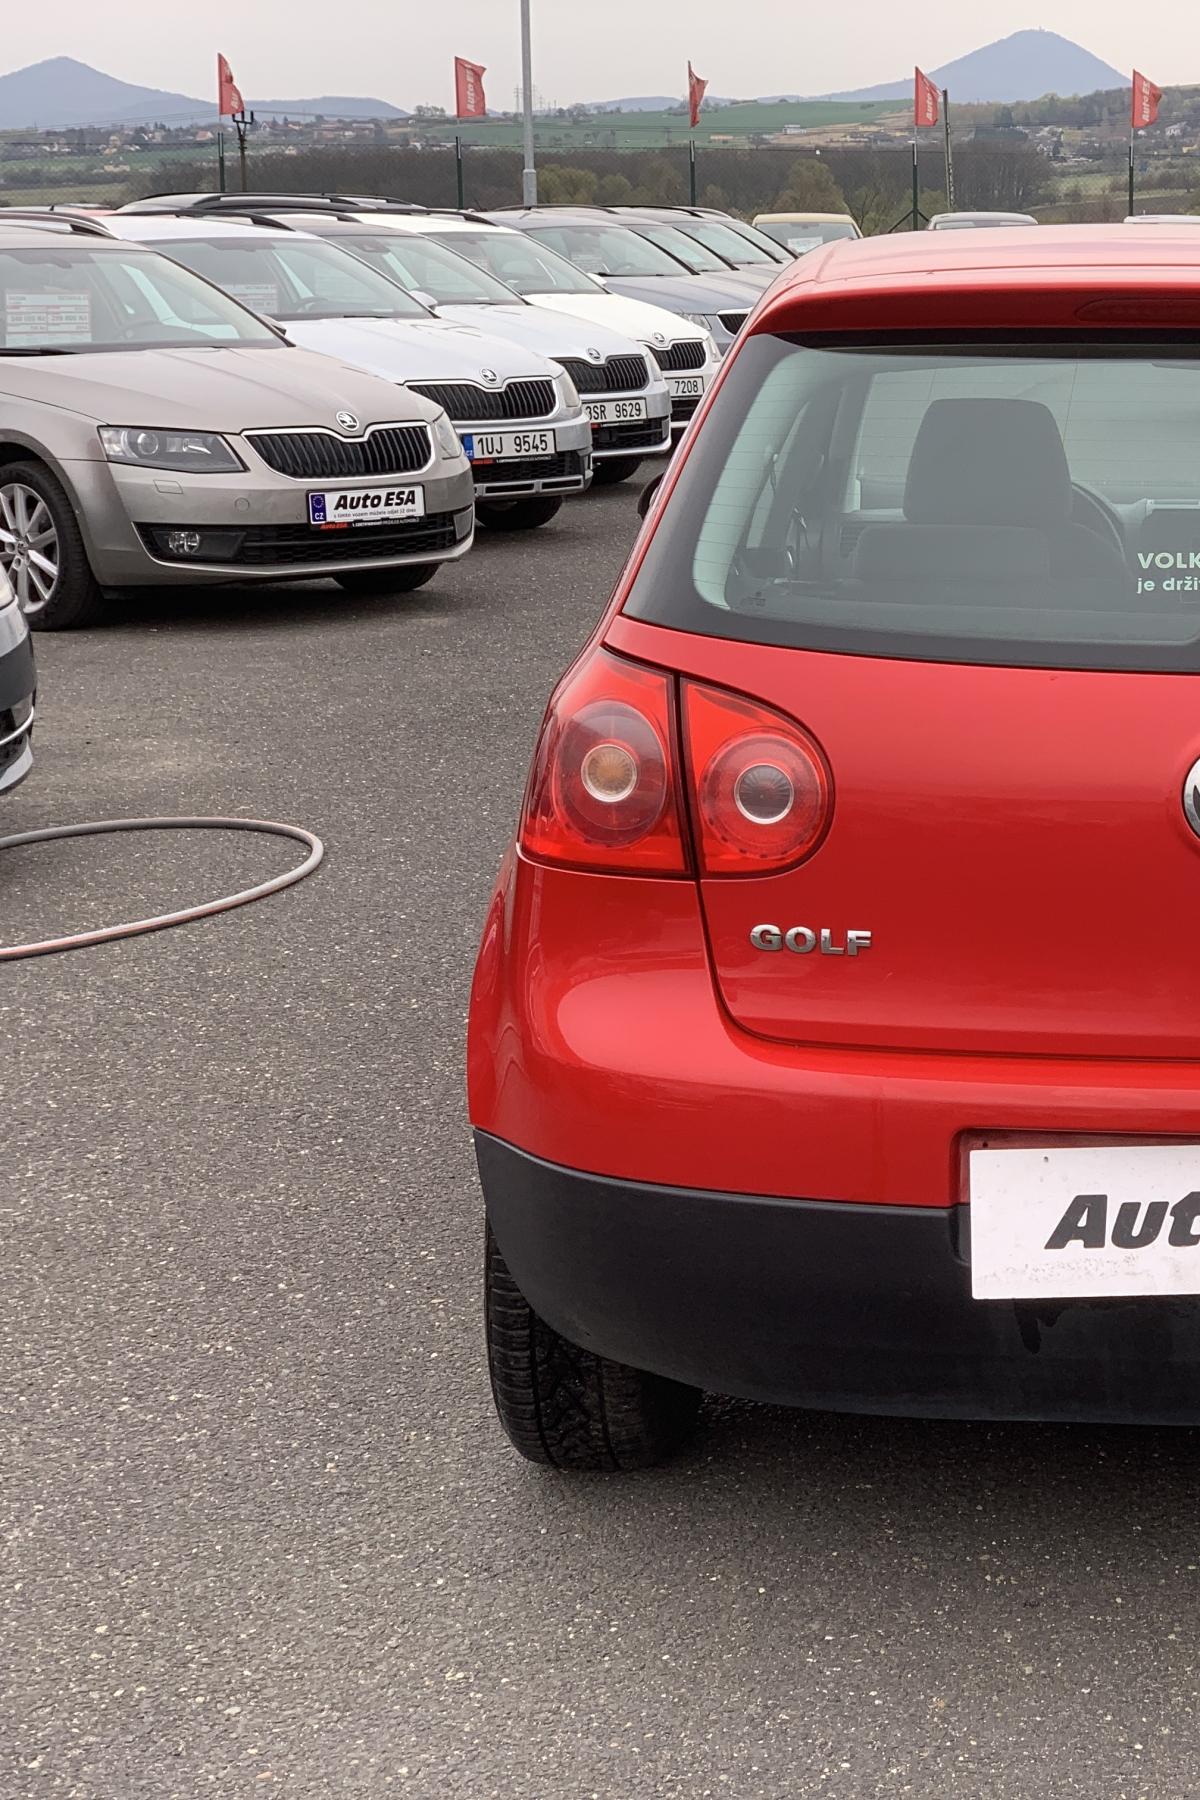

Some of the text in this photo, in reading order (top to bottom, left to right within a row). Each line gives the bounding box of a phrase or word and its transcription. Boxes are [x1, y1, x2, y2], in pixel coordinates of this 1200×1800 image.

[674, 380, 699, 394] 7208
[585, 402, 642, 420] 3SR 9629
[477, 434, 548, 455] 1UJ 9545
[333, 490, 416, 511] Auto ESA
[314, 512, 325, 520] CZ
[1136, 577, 1155, 594] je
[750, 924, 872, 956] GOLF
